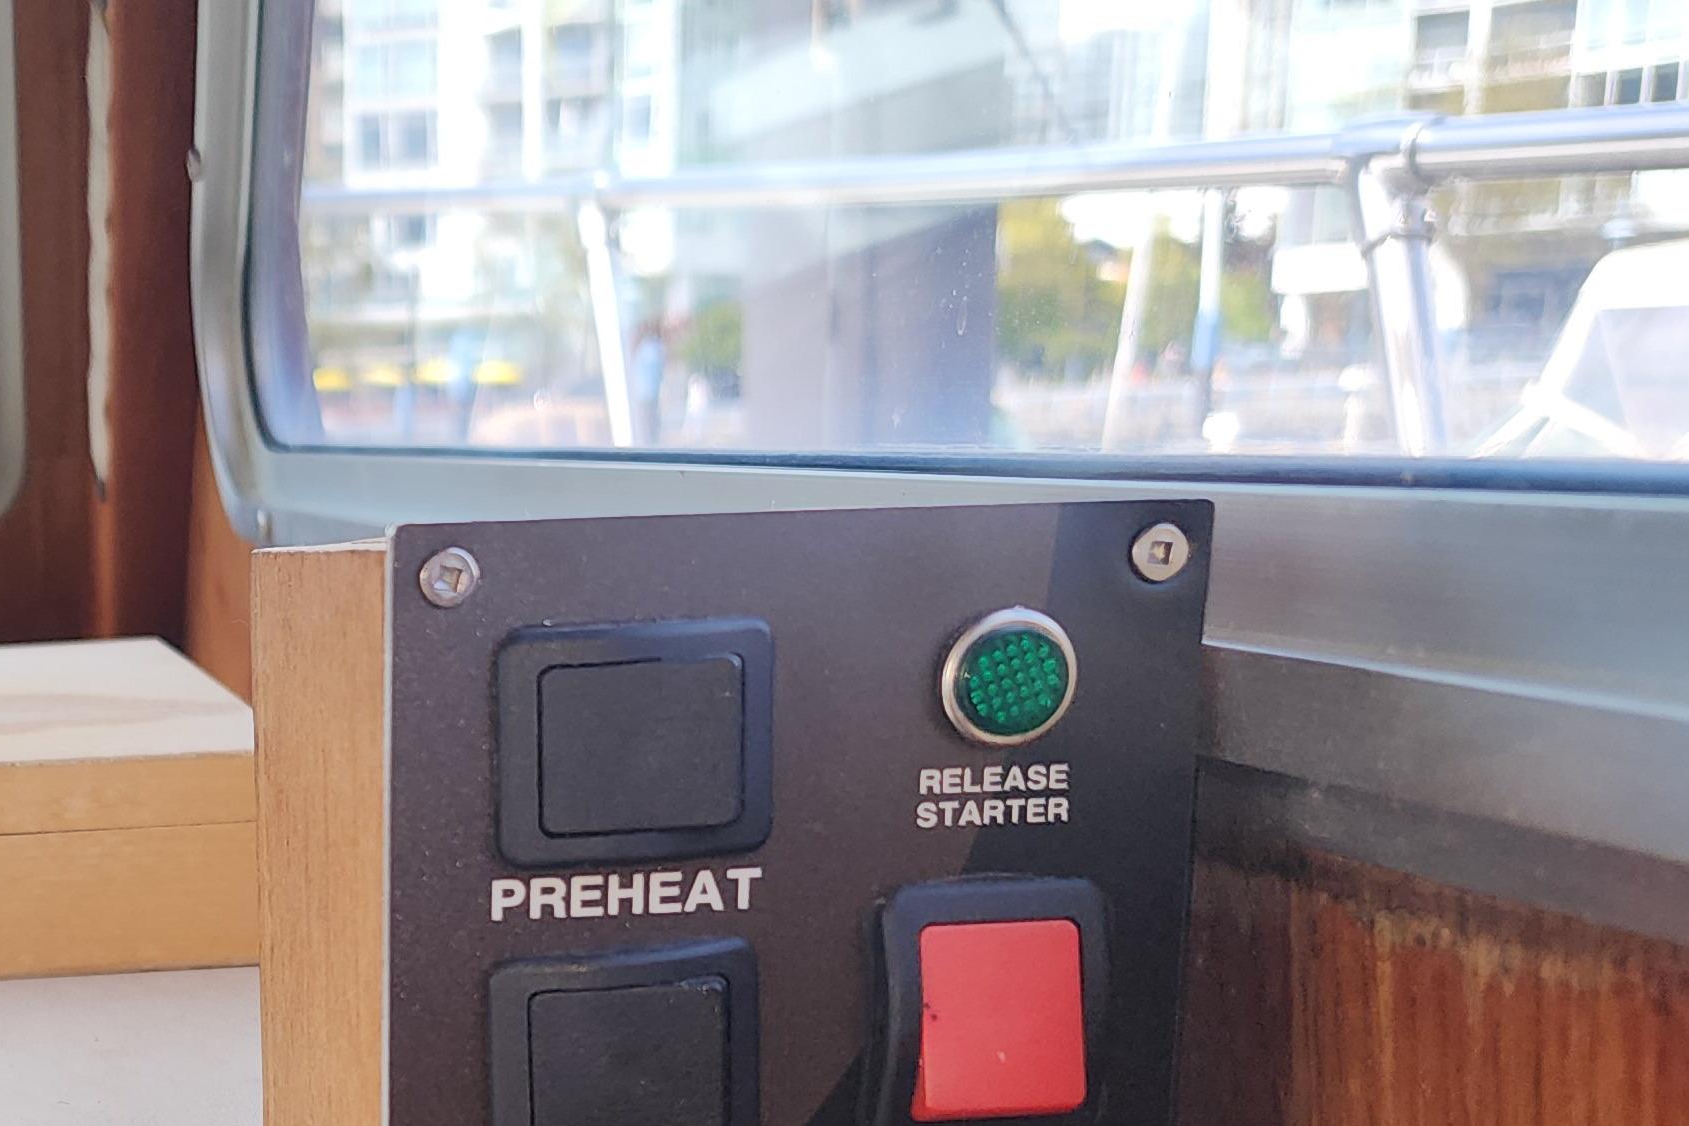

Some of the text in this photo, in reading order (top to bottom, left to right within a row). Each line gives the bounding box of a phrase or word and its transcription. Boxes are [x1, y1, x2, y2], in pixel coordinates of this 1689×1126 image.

[919, 763, 1069, 795] RELEASE
[916, 797, 1069, 828] STARTER
[490, 866, 763, 922] PREHEAT
